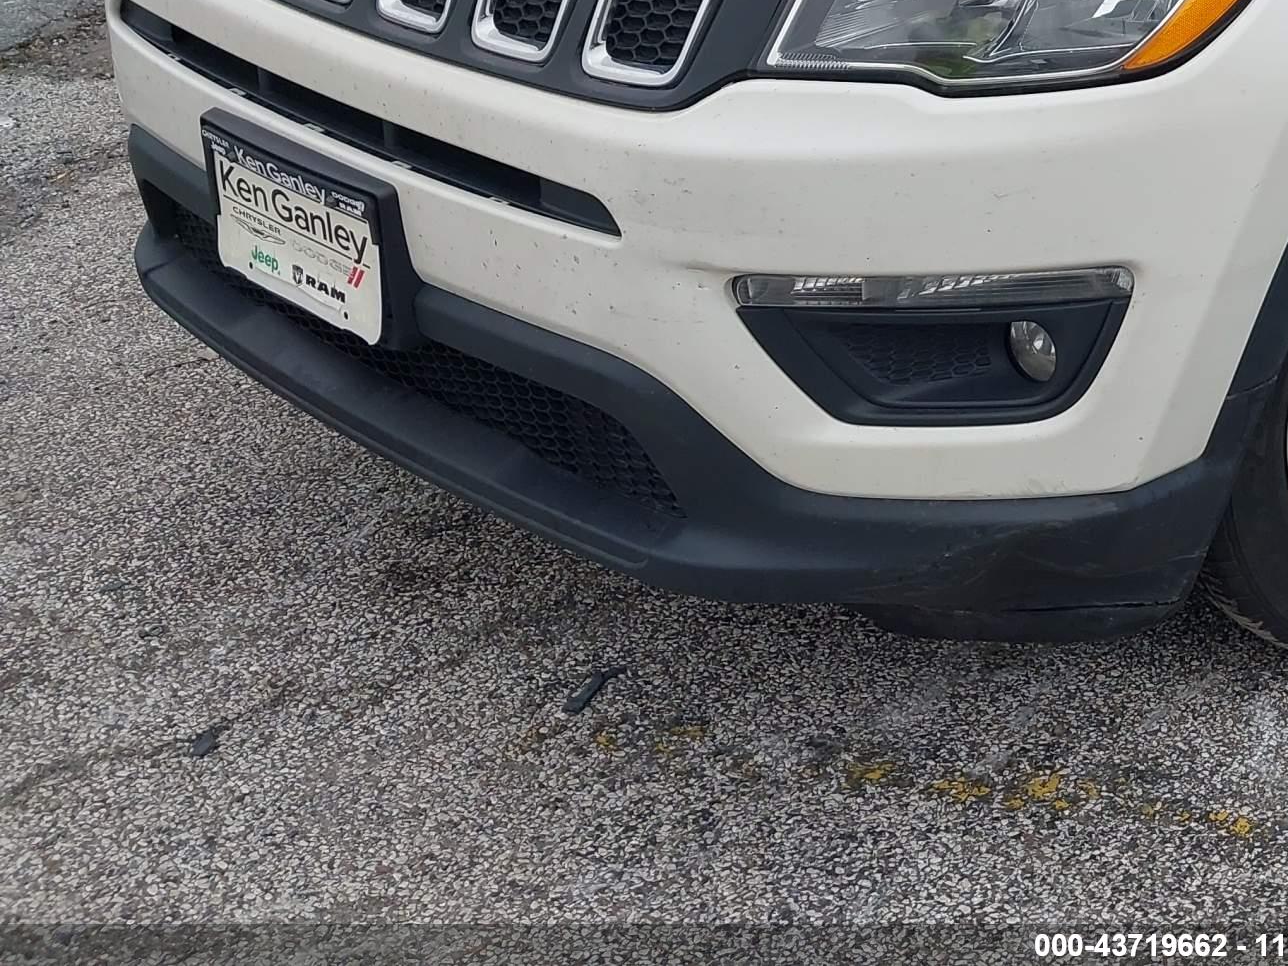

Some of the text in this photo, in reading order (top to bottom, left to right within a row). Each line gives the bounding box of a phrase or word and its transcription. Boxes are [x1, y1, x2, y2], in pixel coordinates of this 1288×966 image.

[234, 146, 325, 205] Ken Ganley
[218, 158, 368, 264] Ken Ganley
[232, 205, 282, 235] CHRYSLER
[251, 244, 279, 273] Jeep
[291, 239, 352, 277] DODGE
[305, 274, 346, 304] RAM
